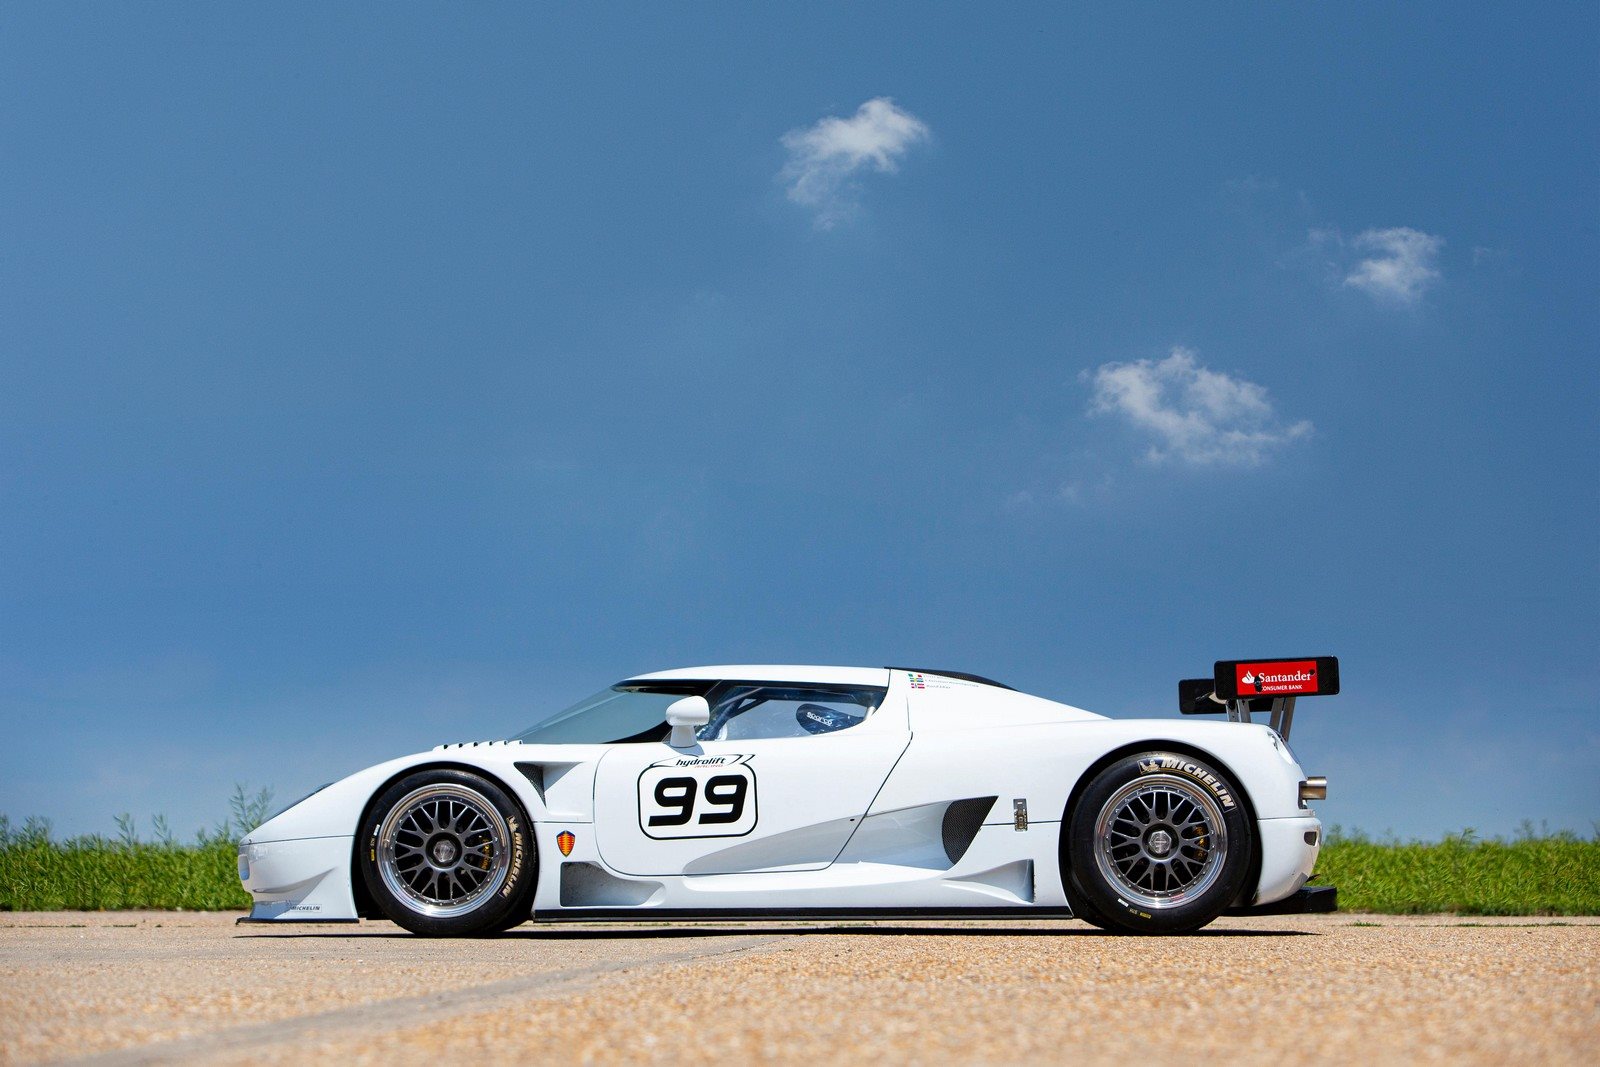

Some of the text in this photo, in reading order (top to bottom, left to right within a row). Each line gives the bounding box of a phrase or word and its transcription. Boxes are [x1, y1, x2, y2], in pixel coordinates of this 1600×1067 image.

[1258, 670, 1311, 682] Santander
[676, 757, 726, 767] hydrolift
[1161, 759, 1235, 808] MICHELIN
[648, 774, 748, 827] 99
[502, 832, 523, 897] MICHELIN
